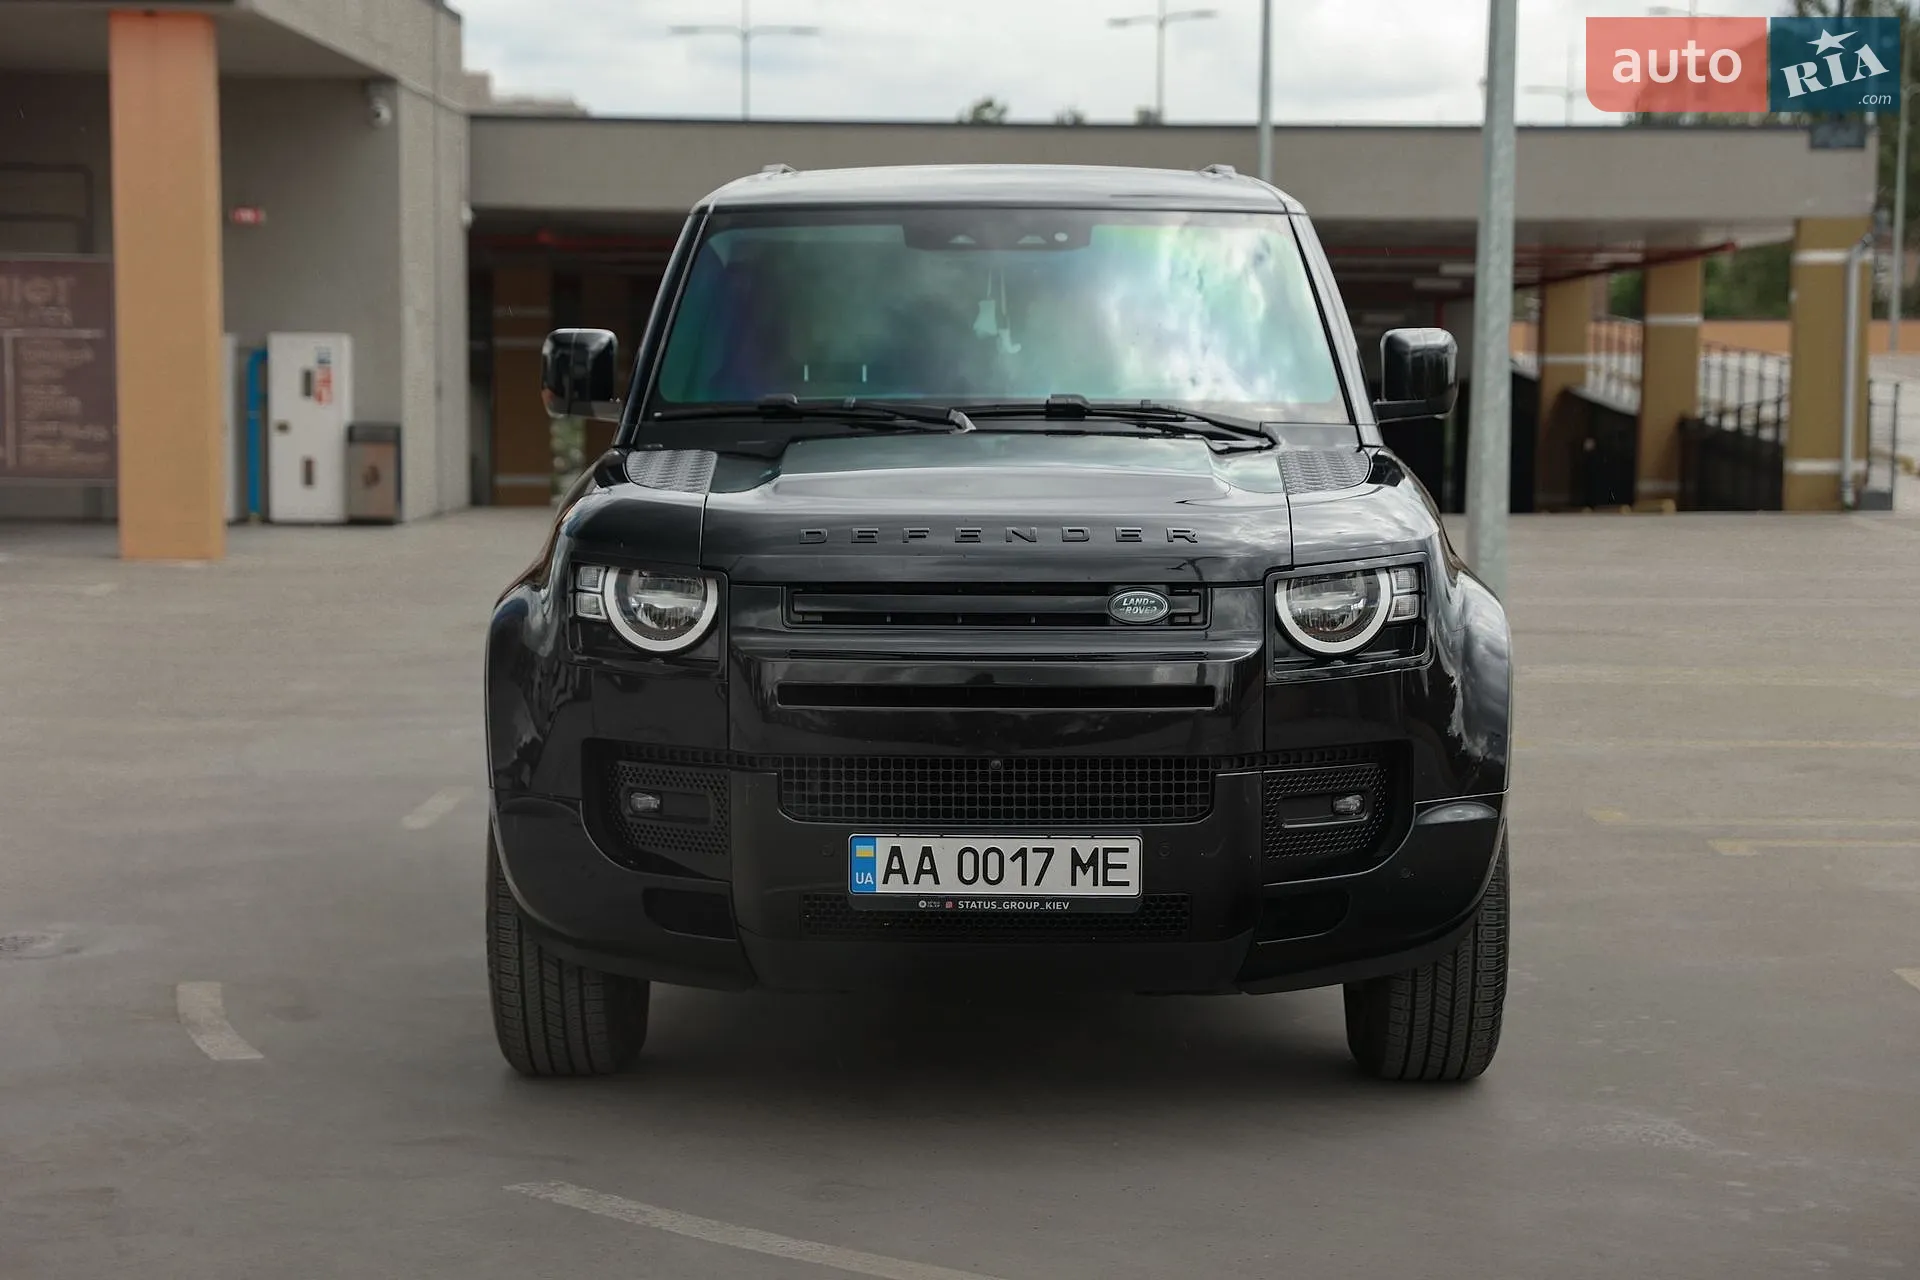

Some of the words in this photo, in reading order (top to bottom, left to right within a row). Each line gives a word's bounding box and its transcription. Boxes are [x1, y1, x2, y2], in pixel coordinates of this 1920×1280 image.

[800, 526, 1199, 544] DEFENDER
[882, 845, 940, 885] AA
[957, 846, 1055, 886] 0017
[1070, 847, 1130, 887] ME
[856, 872, 874, 885] UA
